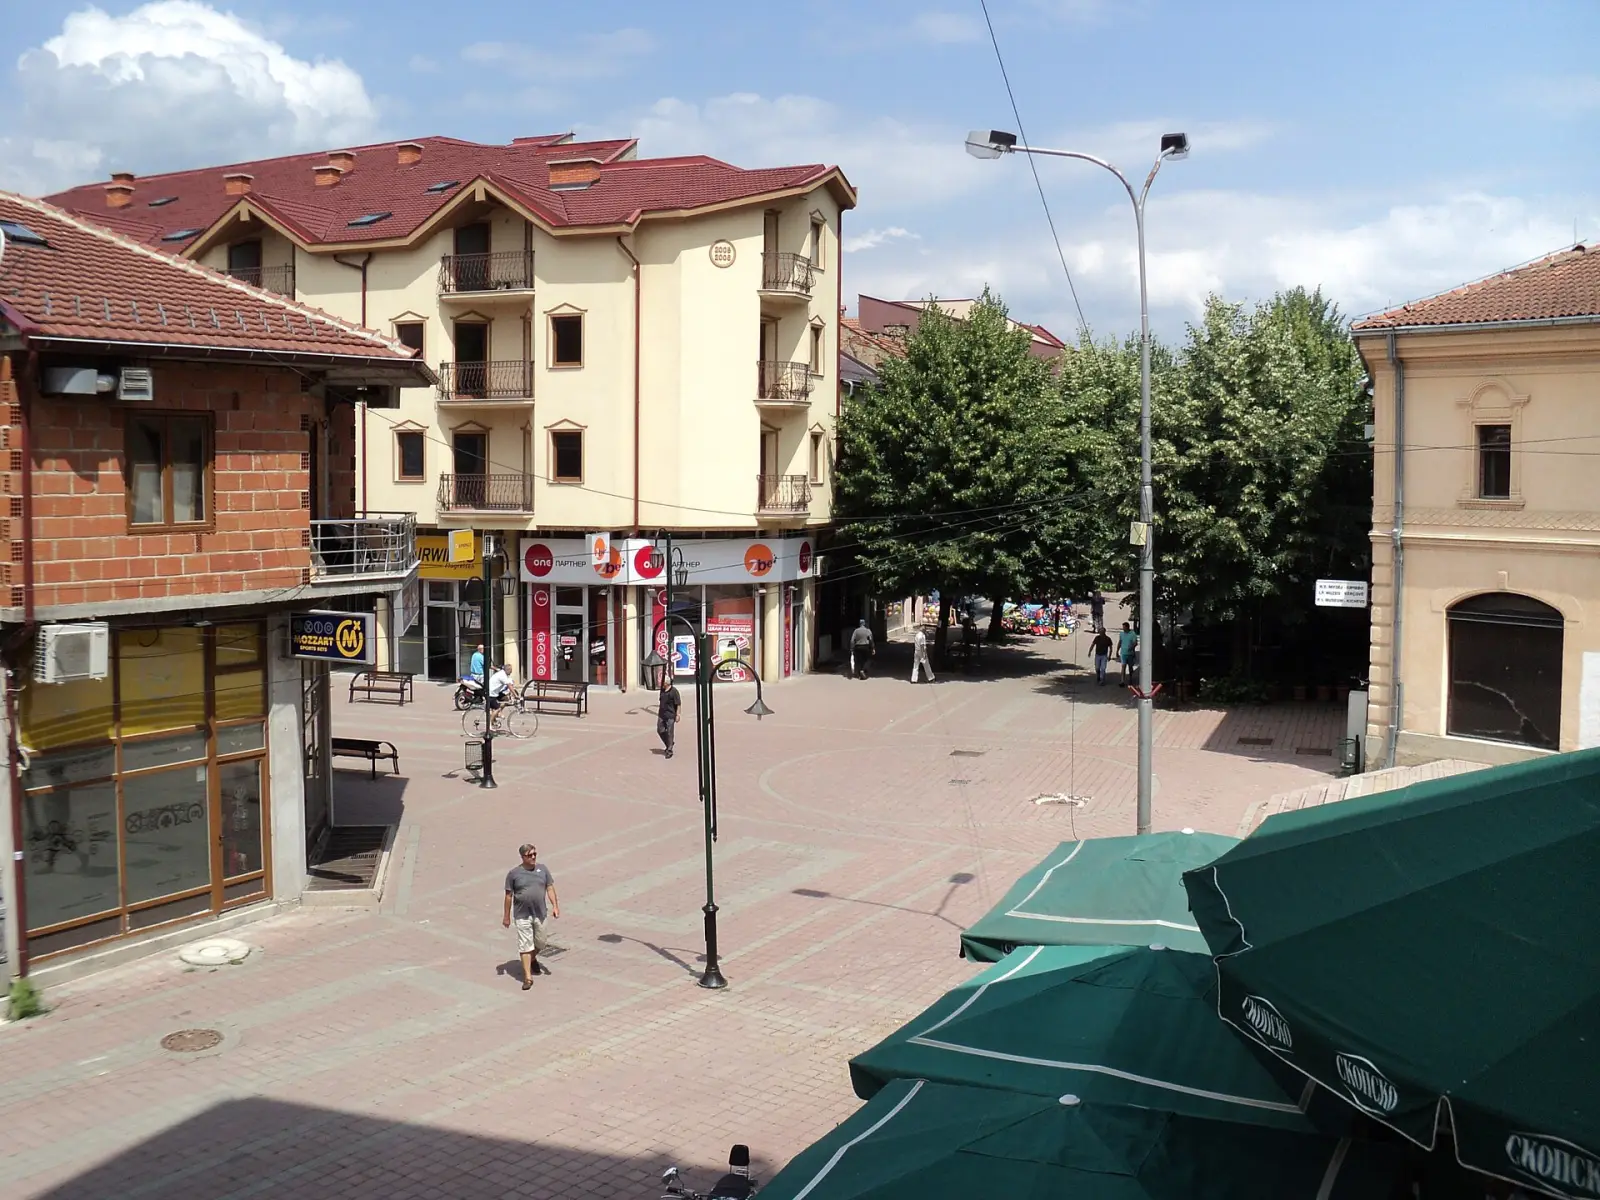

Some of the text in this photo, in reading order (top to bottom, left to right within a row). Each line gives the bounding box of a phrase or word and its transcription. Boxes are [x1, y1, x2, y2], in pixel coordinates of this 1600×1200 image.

[555, 560, 587, 568] ПАРТНЕР
[295, 635, 334, 647] MOZZART
[1242, 996, 1292, 1047] СКОПСКО
[1336, 1055, 1398, 1111] СКОПСКО
